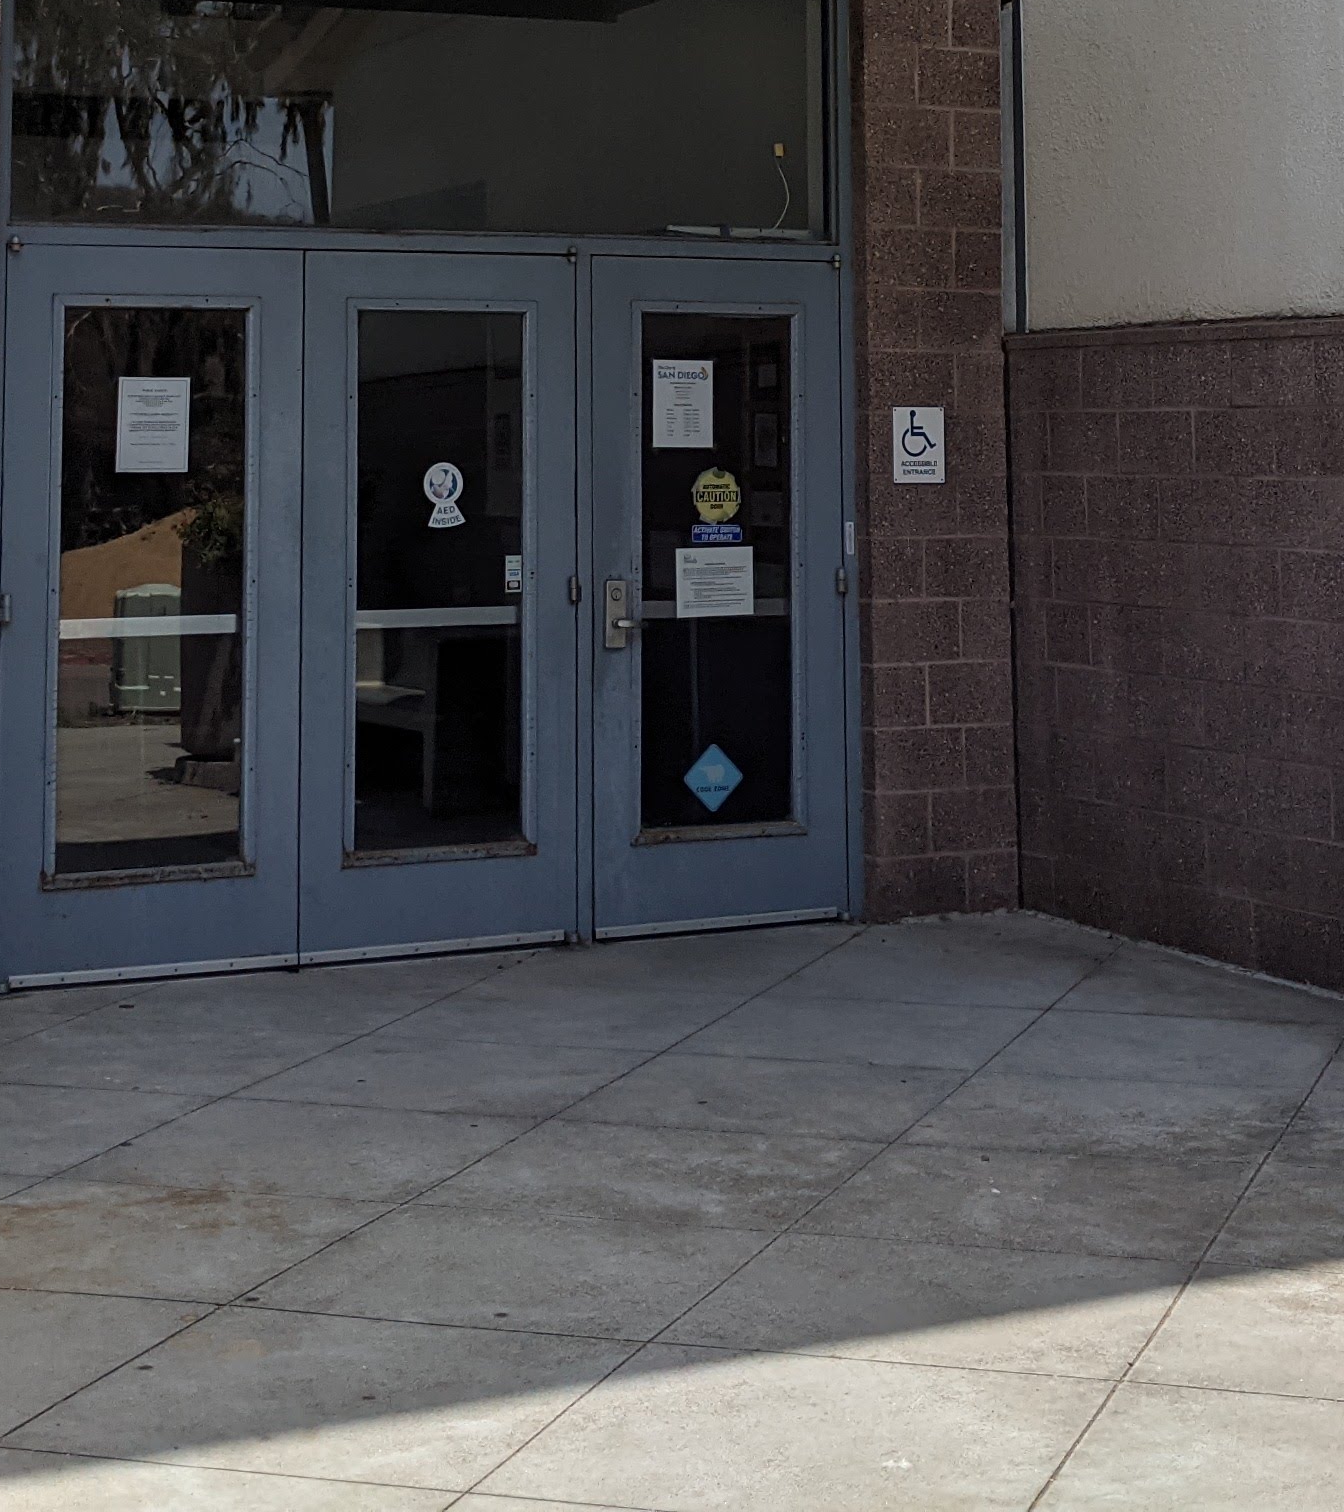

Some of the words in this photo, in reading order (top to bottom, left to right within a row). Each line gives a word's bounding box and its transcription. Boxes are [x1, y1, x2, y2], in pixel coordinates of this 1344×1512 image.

[658, 371, 675, 379] SAN
[678, 371, 705, 380] DIEGO
[697, 491, 736, 502] CAUTION
[437, 506, 455, 514] AED
[432, 515, 462, 525] INSIDE
